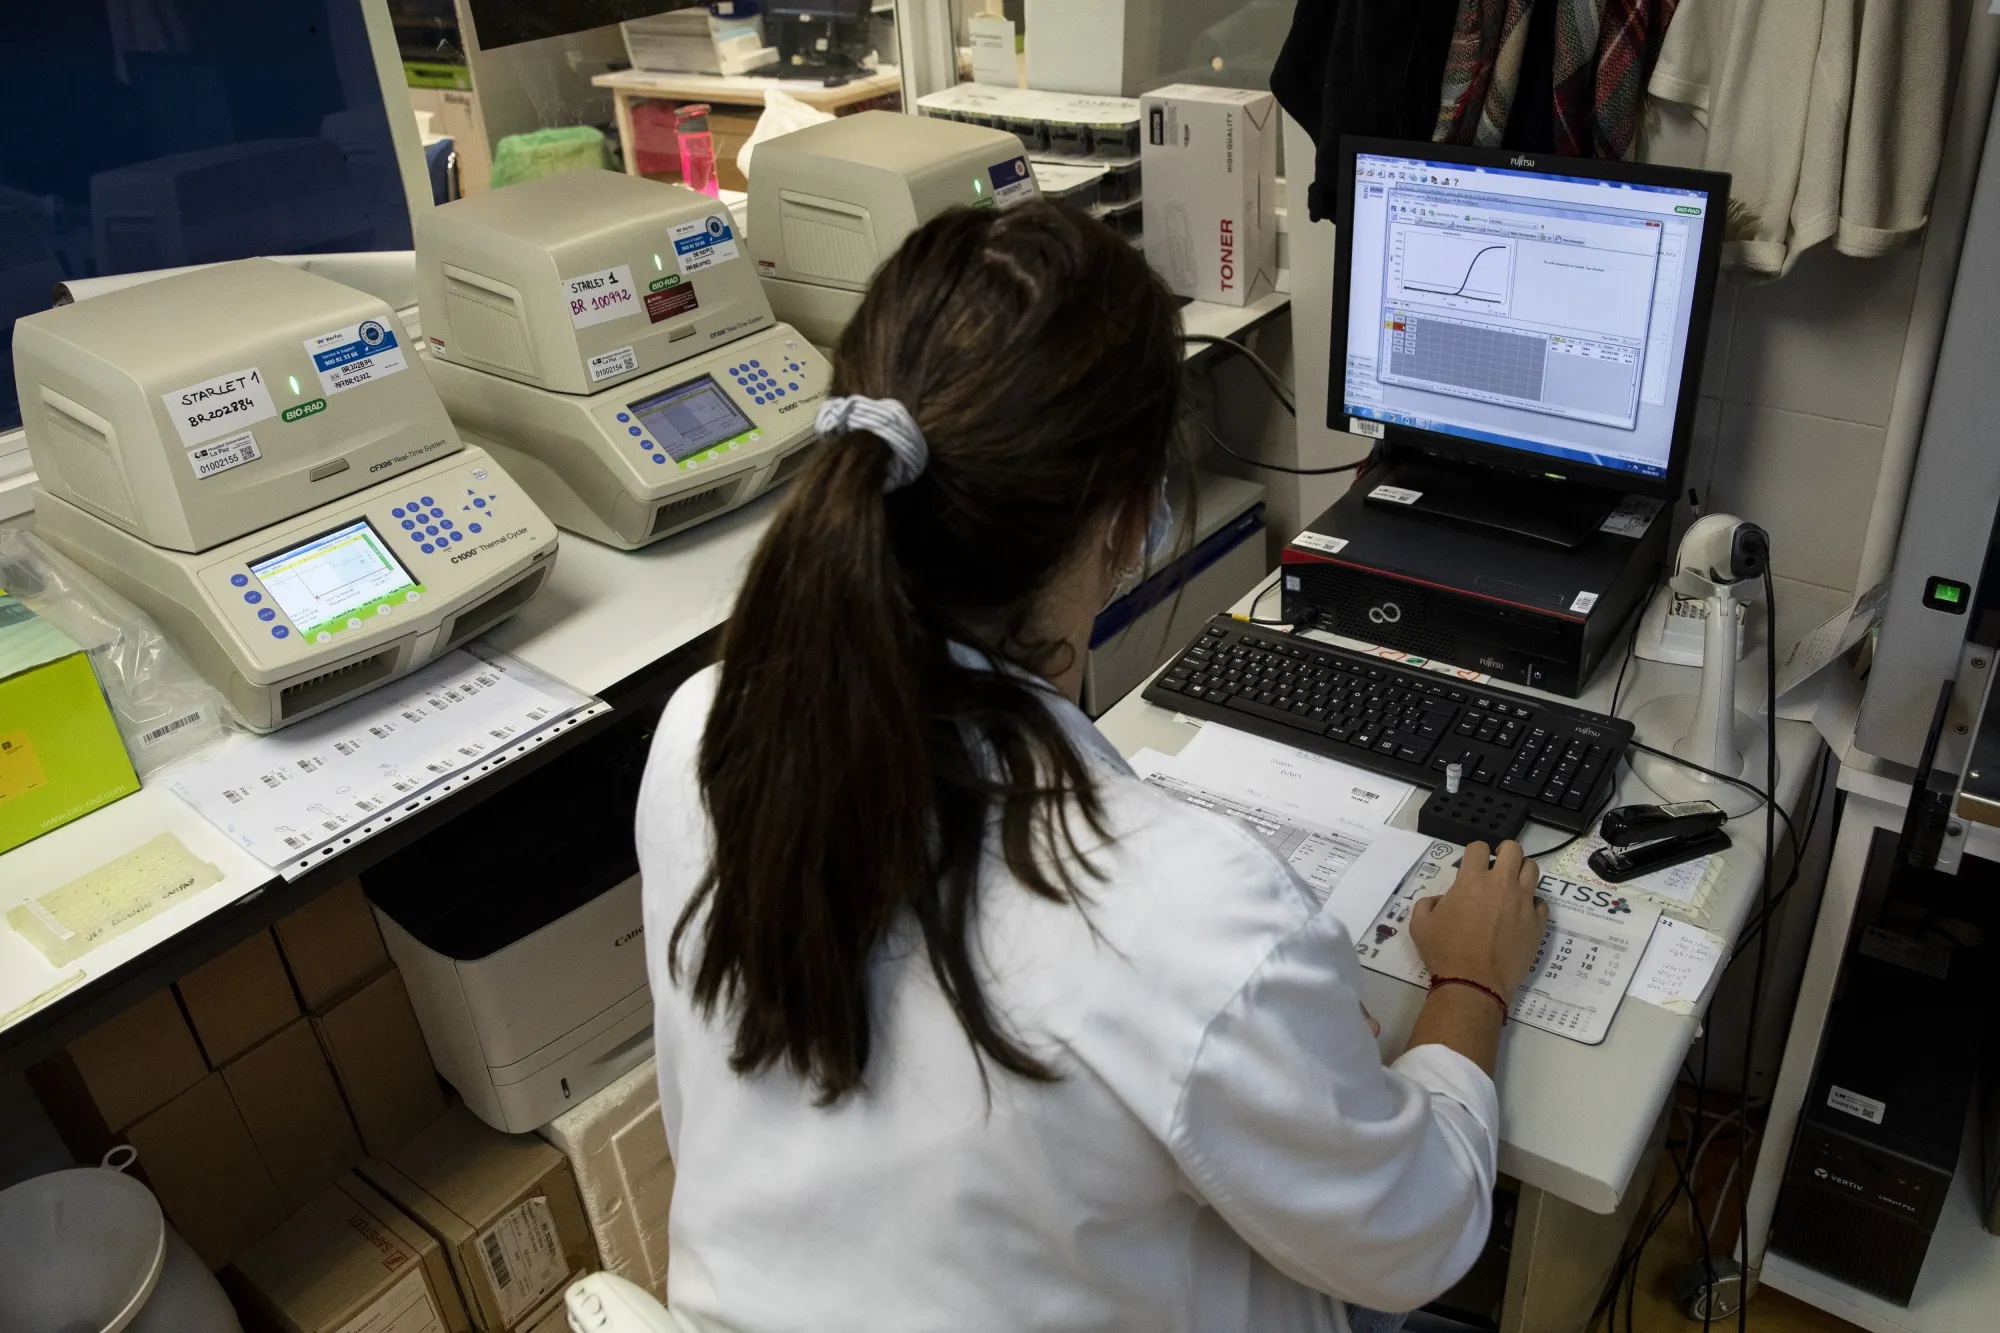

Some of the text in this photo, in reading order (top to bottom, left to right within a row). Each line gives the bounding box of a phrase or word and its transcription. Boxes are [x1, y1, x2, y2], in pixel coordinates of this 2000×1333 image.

[1510, 155, 1535, 167] FUJITSU
[1221, 219, 1234, 292] TONER
[571, 271, 619, 294] STARLET 1
[651, 276, 679, 291] BIO-RAD
[570, 299, 588, 316] BR
[592, 288, 632, 311] 100992
[748, 315, 764, 326] System
[322, 351, 336, 360] Service
[340, 346, 356, 354] Support
[596, 363, 623, 378] 01002154
[181, 370, 261, 406] STARLET 1
[188, 398, 255, 428] BR202884
[286, 400, 324, 420] BIO-RAD
[778, 402, 798, 414] C1000
[208, 434, 250, 452] Hospital Universitario
[210, 446, 230, 458] La Paz
[394, 448, 424, 464] Real-Time
[424, 439, 446, 452] System
[200, 454, 239, 474] 01002155
[479, 537, 507, 552] Thermal
[506, 526, 528, 542] Cycler
[1480, 657, 1504, 670] FUJITSU
[1574, 726, 1601, 738] FUJITSU
[40, 784, 126, 828] www.bio-rad.com
[1576, 873, 1618, 892] ALTONA
[1586, 911, 1625, 925] SANITARIOS
[614, 924, 646, 948] Cano
[1608, 935, 1629, 945] 2021
[1357, 944, 1380, 959] 21
[1560, 946, 1572, 954] 10
[1585, 954, 1596, 962] 11
[1608, 961, 1620, 969] 12
[1555, 954, 1568, 962] 17
[1580, 962, 1593, 970] 18
[1550, 963, 1563, 971] 24
[1576, 971, 1589, 979] 25
[1598, 978, 1611, 986] 26
[1830, 1174, 1863, 1191] VERTIV
[346, 1214, 394, 1253] SARSTEDT
